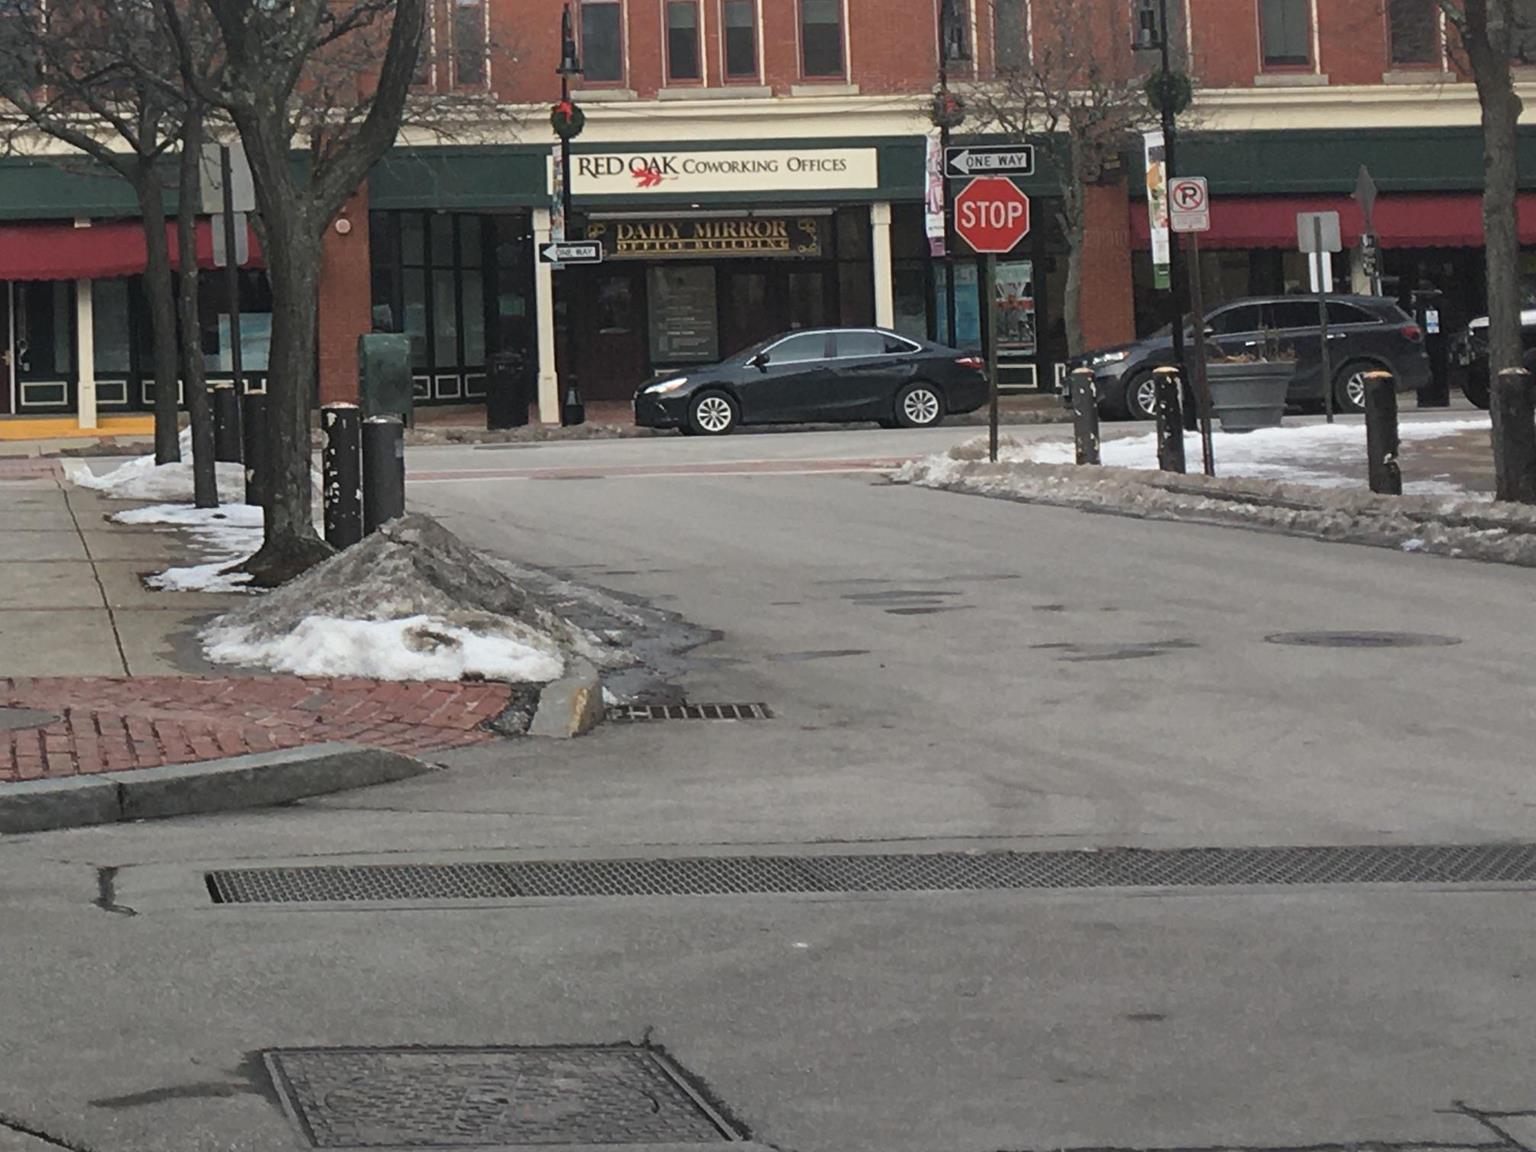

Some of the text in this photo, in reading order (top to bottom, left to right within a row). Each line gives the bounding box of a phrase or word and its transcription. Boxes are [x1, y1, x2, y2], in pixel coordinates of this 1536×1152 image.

[578, 156, 623, 179] RED
[629, 155, 679, 175] OAK
[966, 154, 1024, 168] ONE WAY
[961, 201, 1023, 228] STOP
[617, 220, 788, 239] DAILY MIRROR
